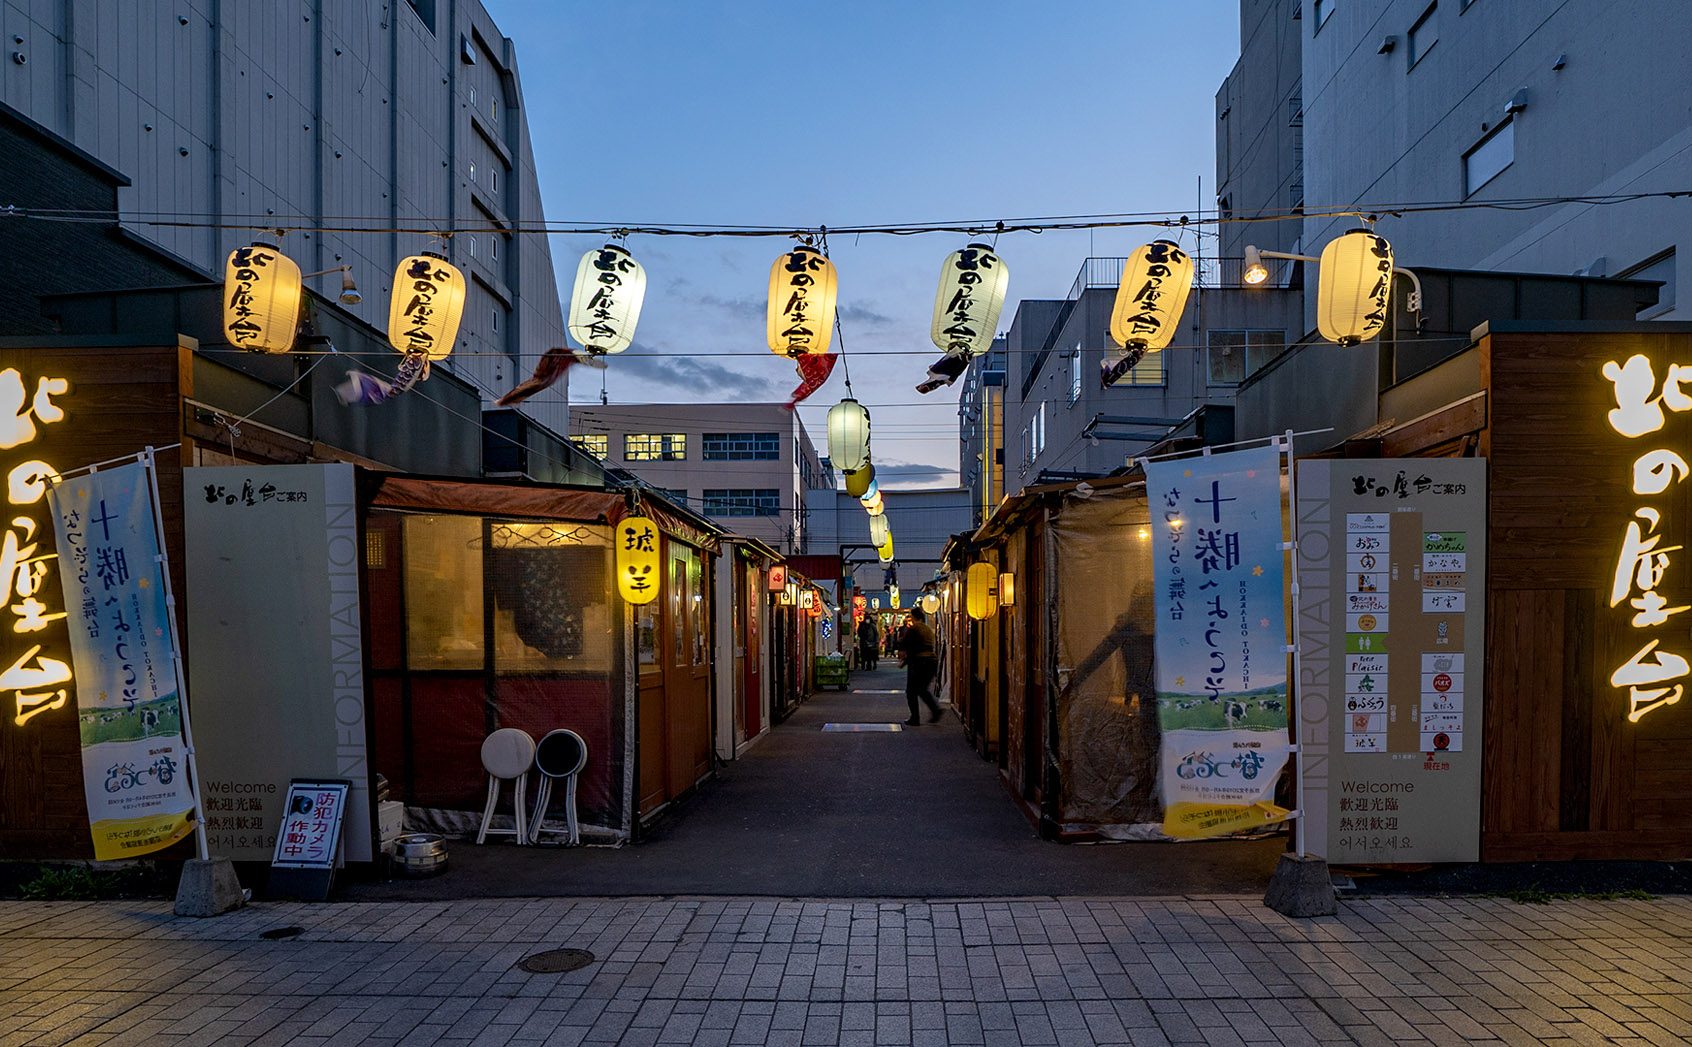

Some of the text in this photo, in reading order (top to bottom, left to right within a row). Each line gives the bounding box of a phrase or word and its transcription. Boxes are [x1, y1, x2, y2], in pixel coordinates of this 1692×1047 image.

[1423, 762, 1449, 771] 現在地
[206, 781, 277, 793] Welcome
[1342, 781, 1414, 793] Welcome
[307, 792, 336, 859] 防犯カメラ
[284, 820, 309, 857] 作動中
[1340, 836, 1414, 850] 어서오세요
